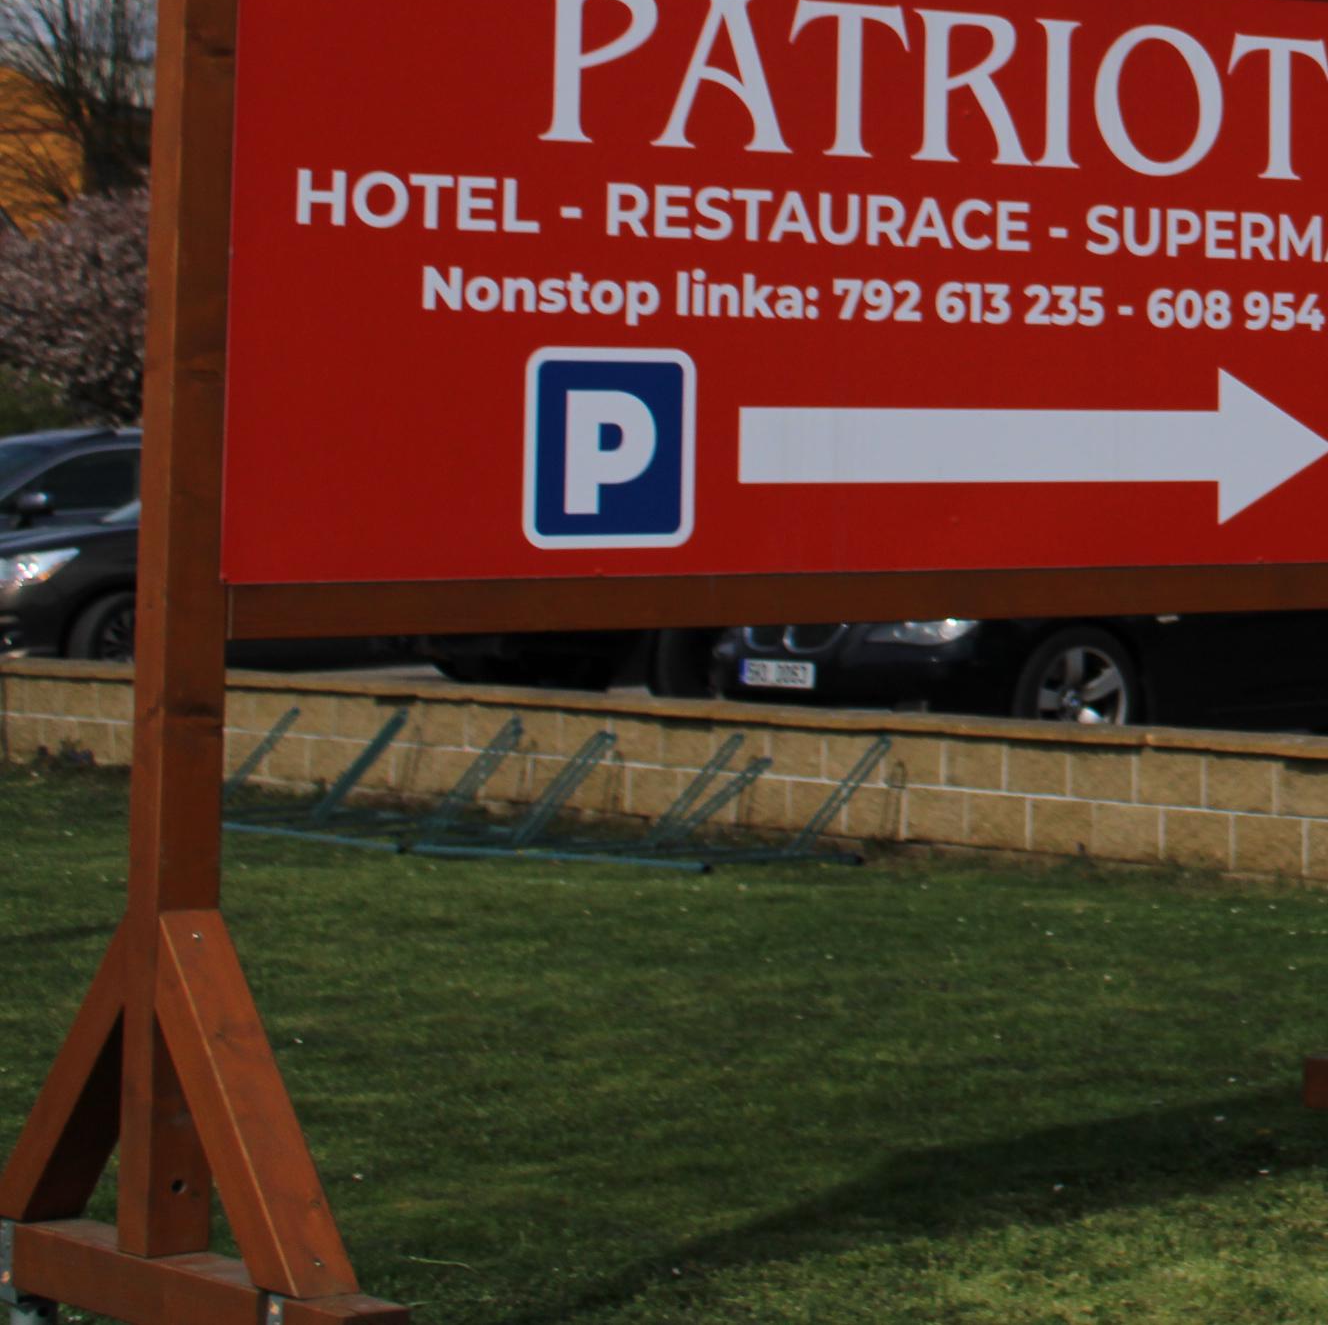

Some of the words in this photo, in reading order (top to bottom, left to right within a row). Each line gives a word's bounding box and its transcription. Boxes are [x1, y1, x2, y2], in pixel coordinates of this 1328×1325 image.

[295, 167, 541, 235] HOTEL
[605, 181, 1032, 253] RESTAURACE
[421, 264, 661, 328] Nonstop
[675, 267, 821, 321] linka:
[832, 277, 924, 323] 792
[934, 280, 1013, 326] 613
[1022, 283, 1106, 328] 235
[1145, 286, 1233, 331] 608
[1242, 289, 1327, 333] 954
[563, 389, 657, 516] P
